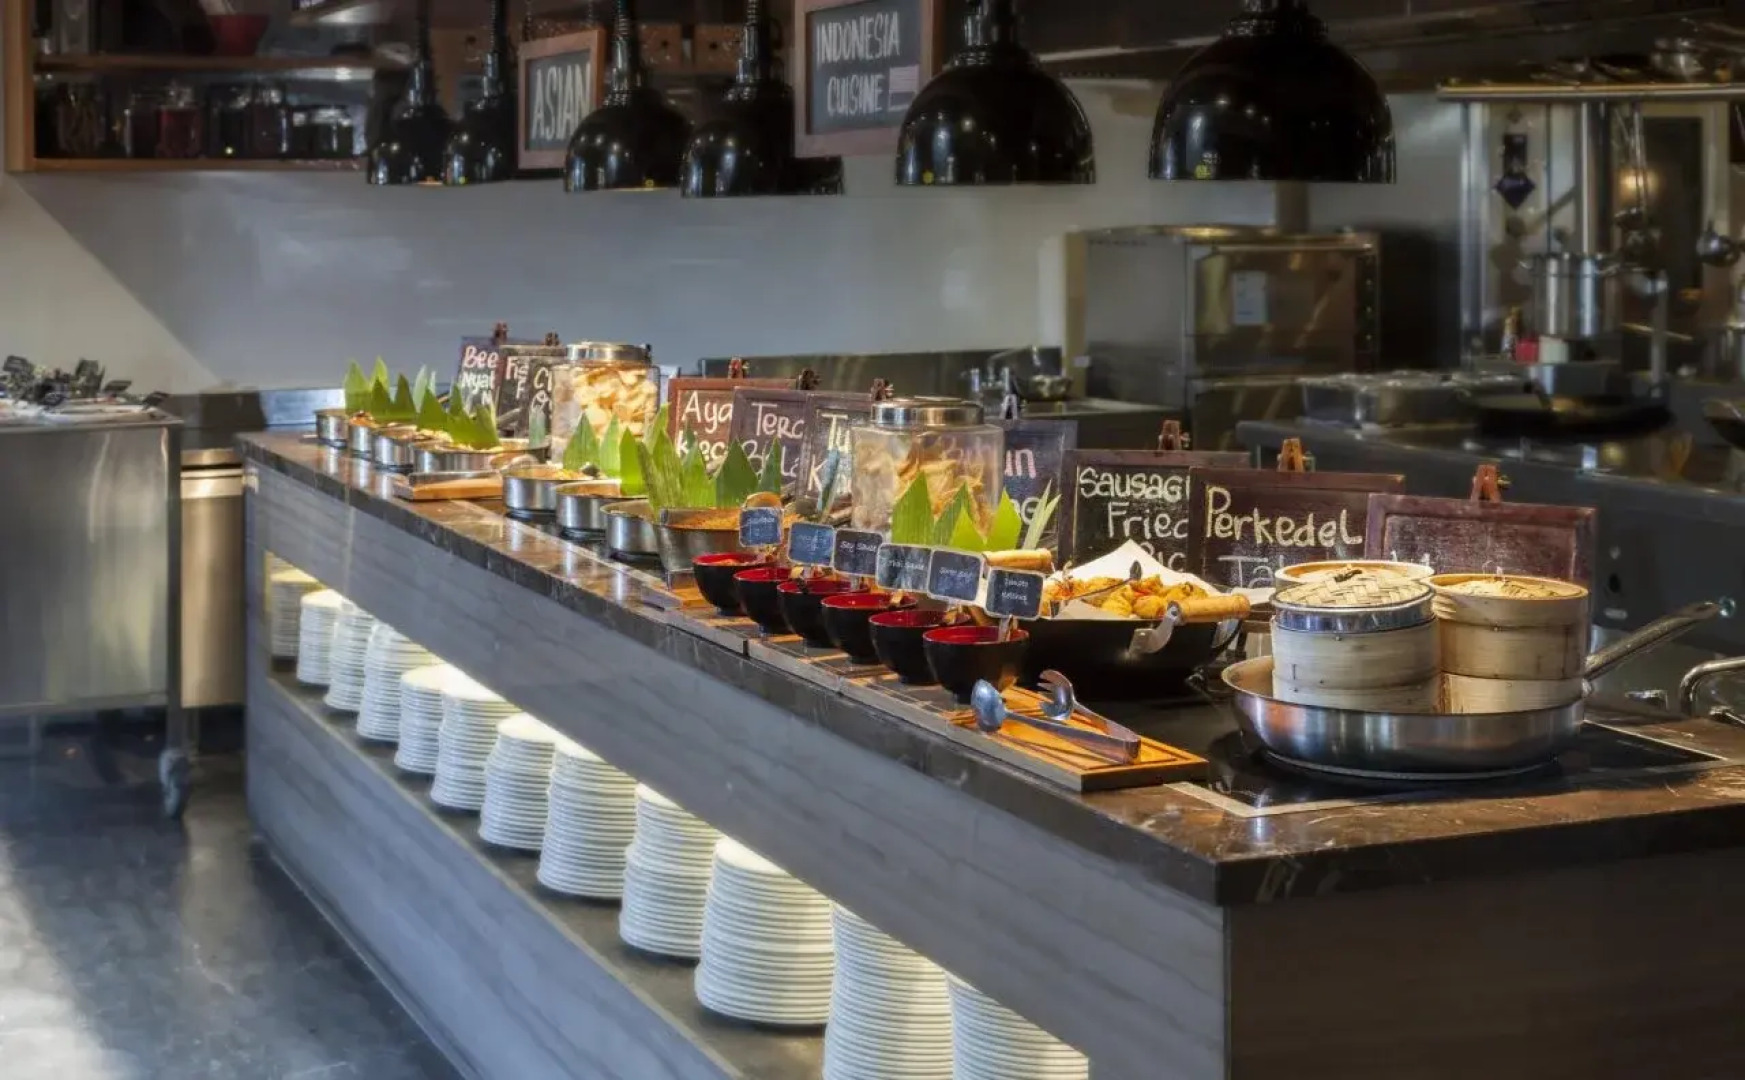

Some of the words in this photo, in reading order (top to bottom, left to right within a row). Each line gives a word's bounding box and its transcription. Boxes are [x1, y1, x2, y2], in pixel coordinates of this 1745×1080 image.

[816, 11, 900, 67] INDONESIA
[531, 63, 591, 141] ASIAN
[827, 74, 884, 116] CUISINE
[1206, 486, 1363, 548] Perkedel
